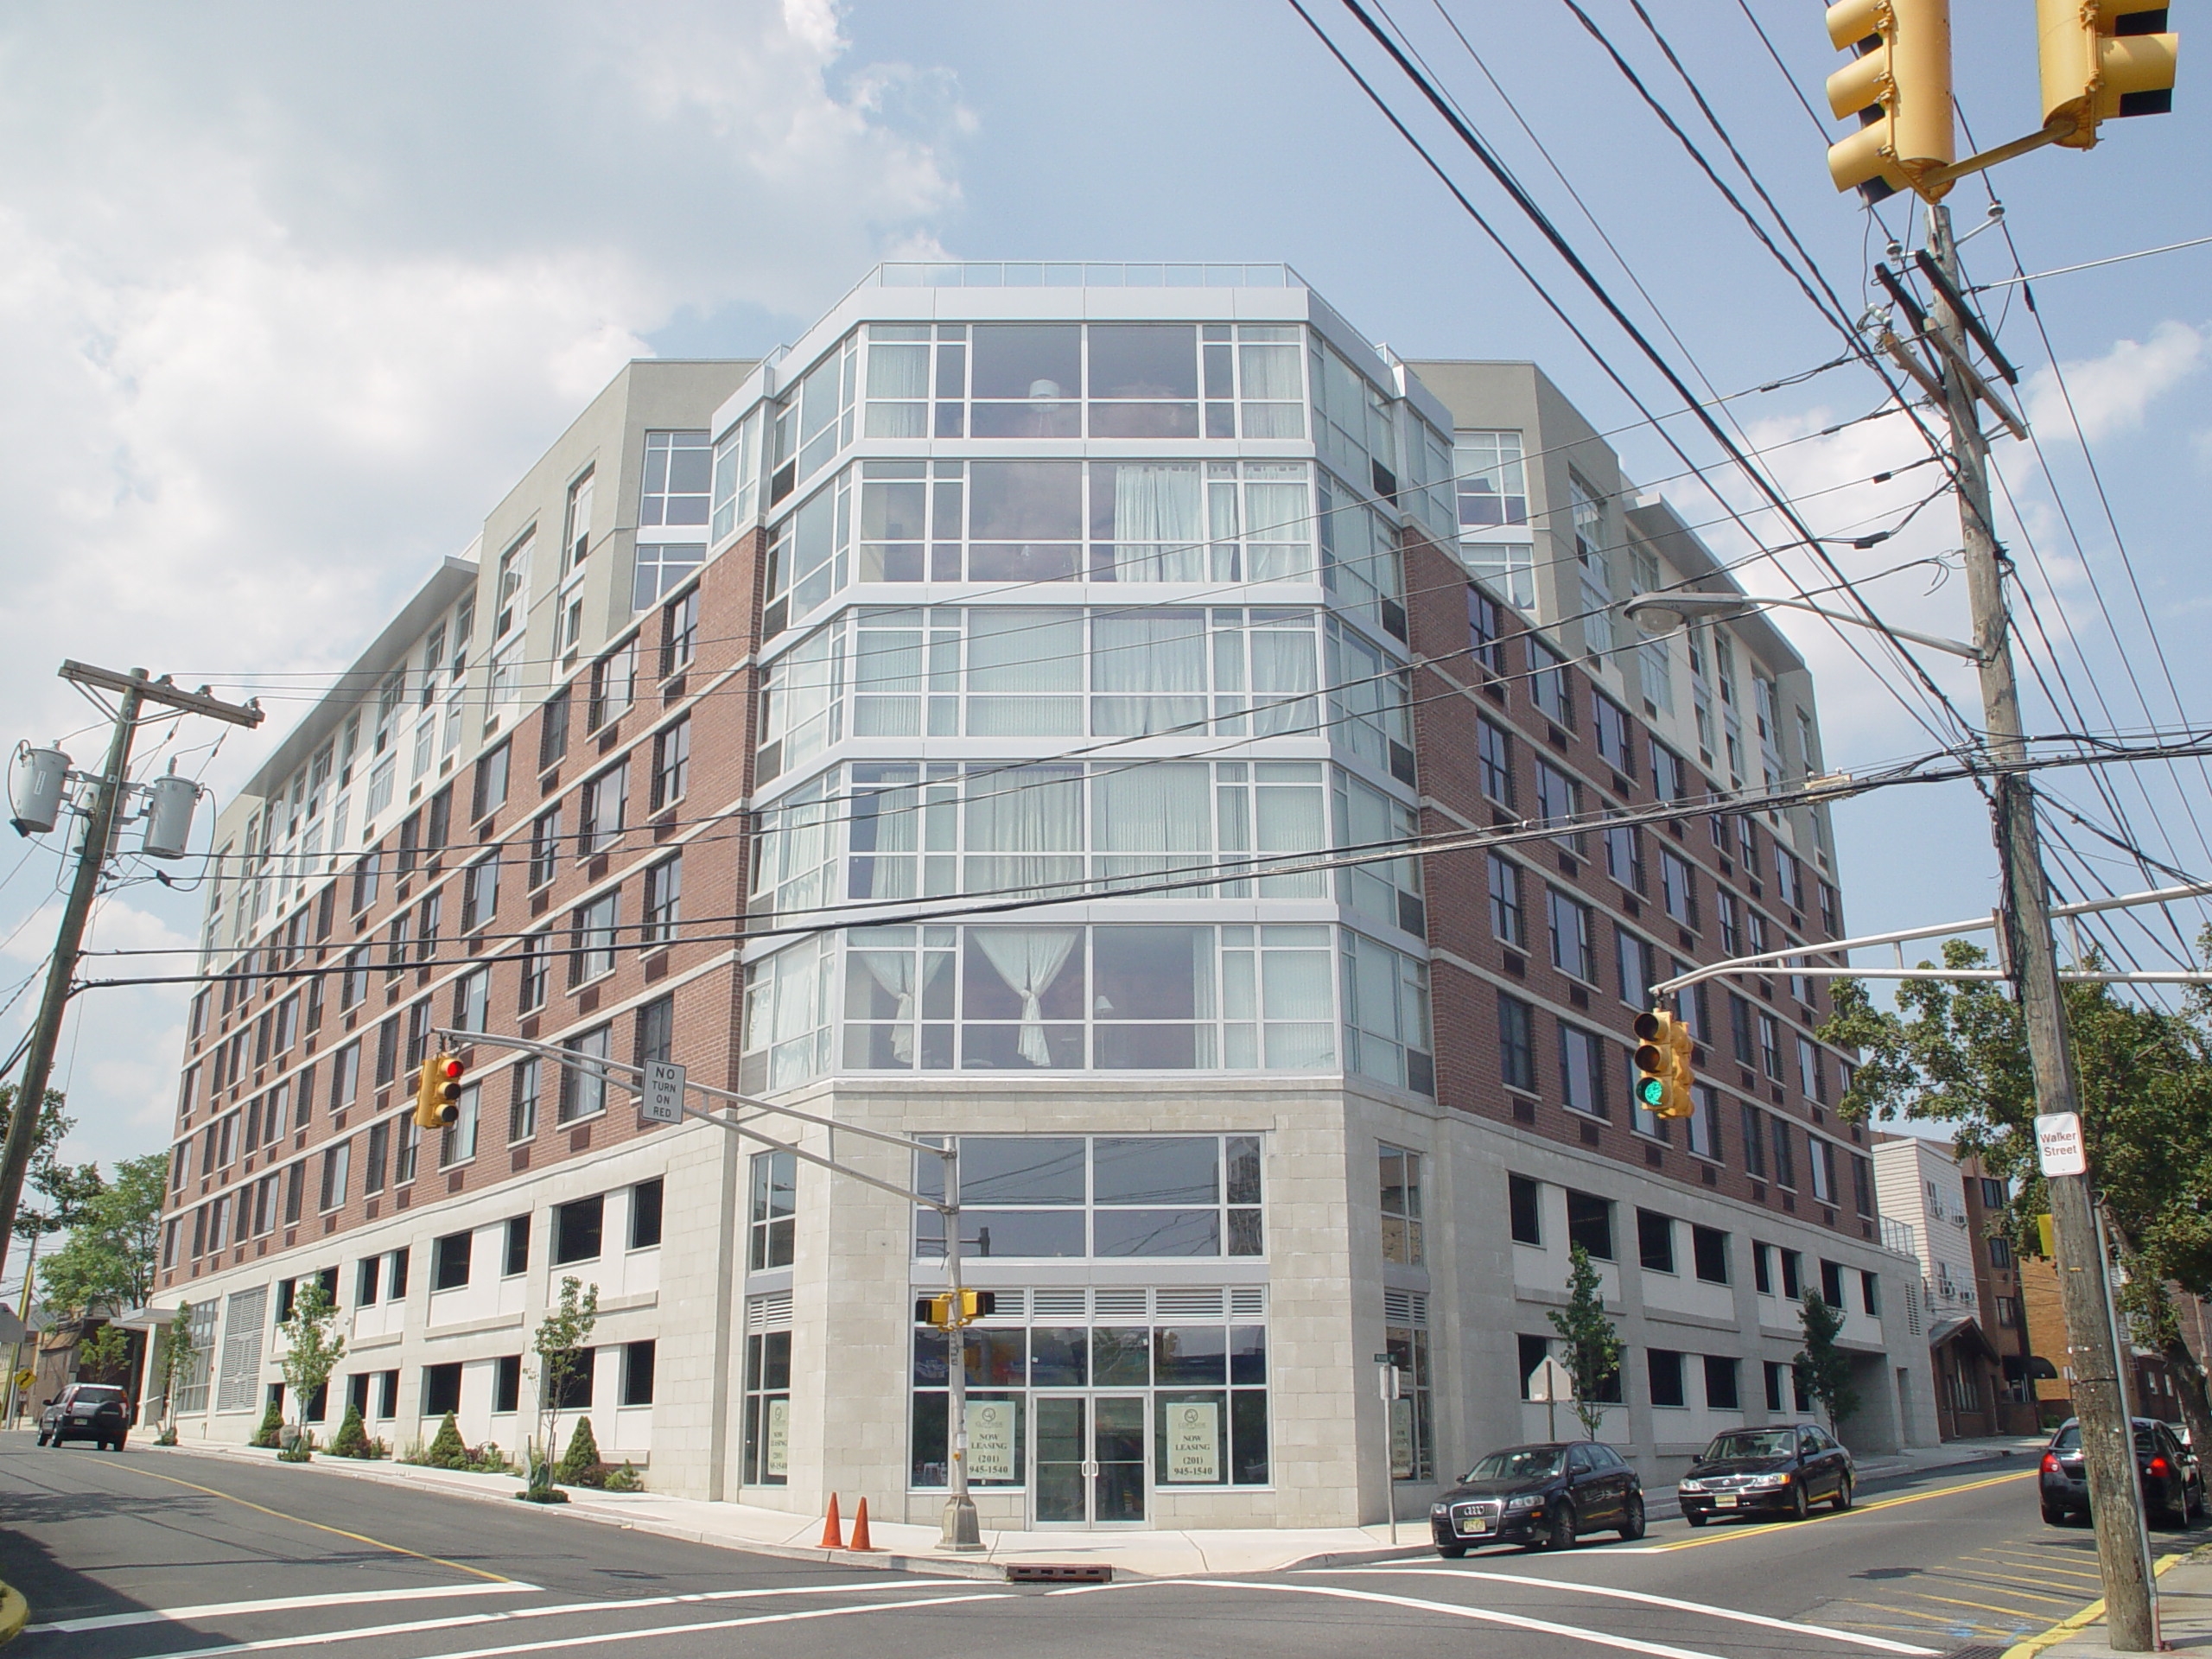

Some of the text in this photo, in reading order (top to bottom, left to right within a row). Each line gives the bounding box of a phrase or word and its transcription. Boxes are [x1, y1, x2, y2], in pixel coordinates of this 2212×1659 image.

[655, 1066, 676, 1080] NO
[652, 1080, 677, 1092] TURN
[656, 1095, 671, 1104] ON
[653, 1106, 671, 1117] RED
[2039, 1131, 2076, 1143] Walker
[2044, 1145, 2078, 1156] Street
[970, 1441, 1007, 1450] LEASING
[977, 1454, 1000, 1464] (201)
[1183, 1456, 1204, 1465] (201)
[969, 1465, 1008, 1473] 945-1540
